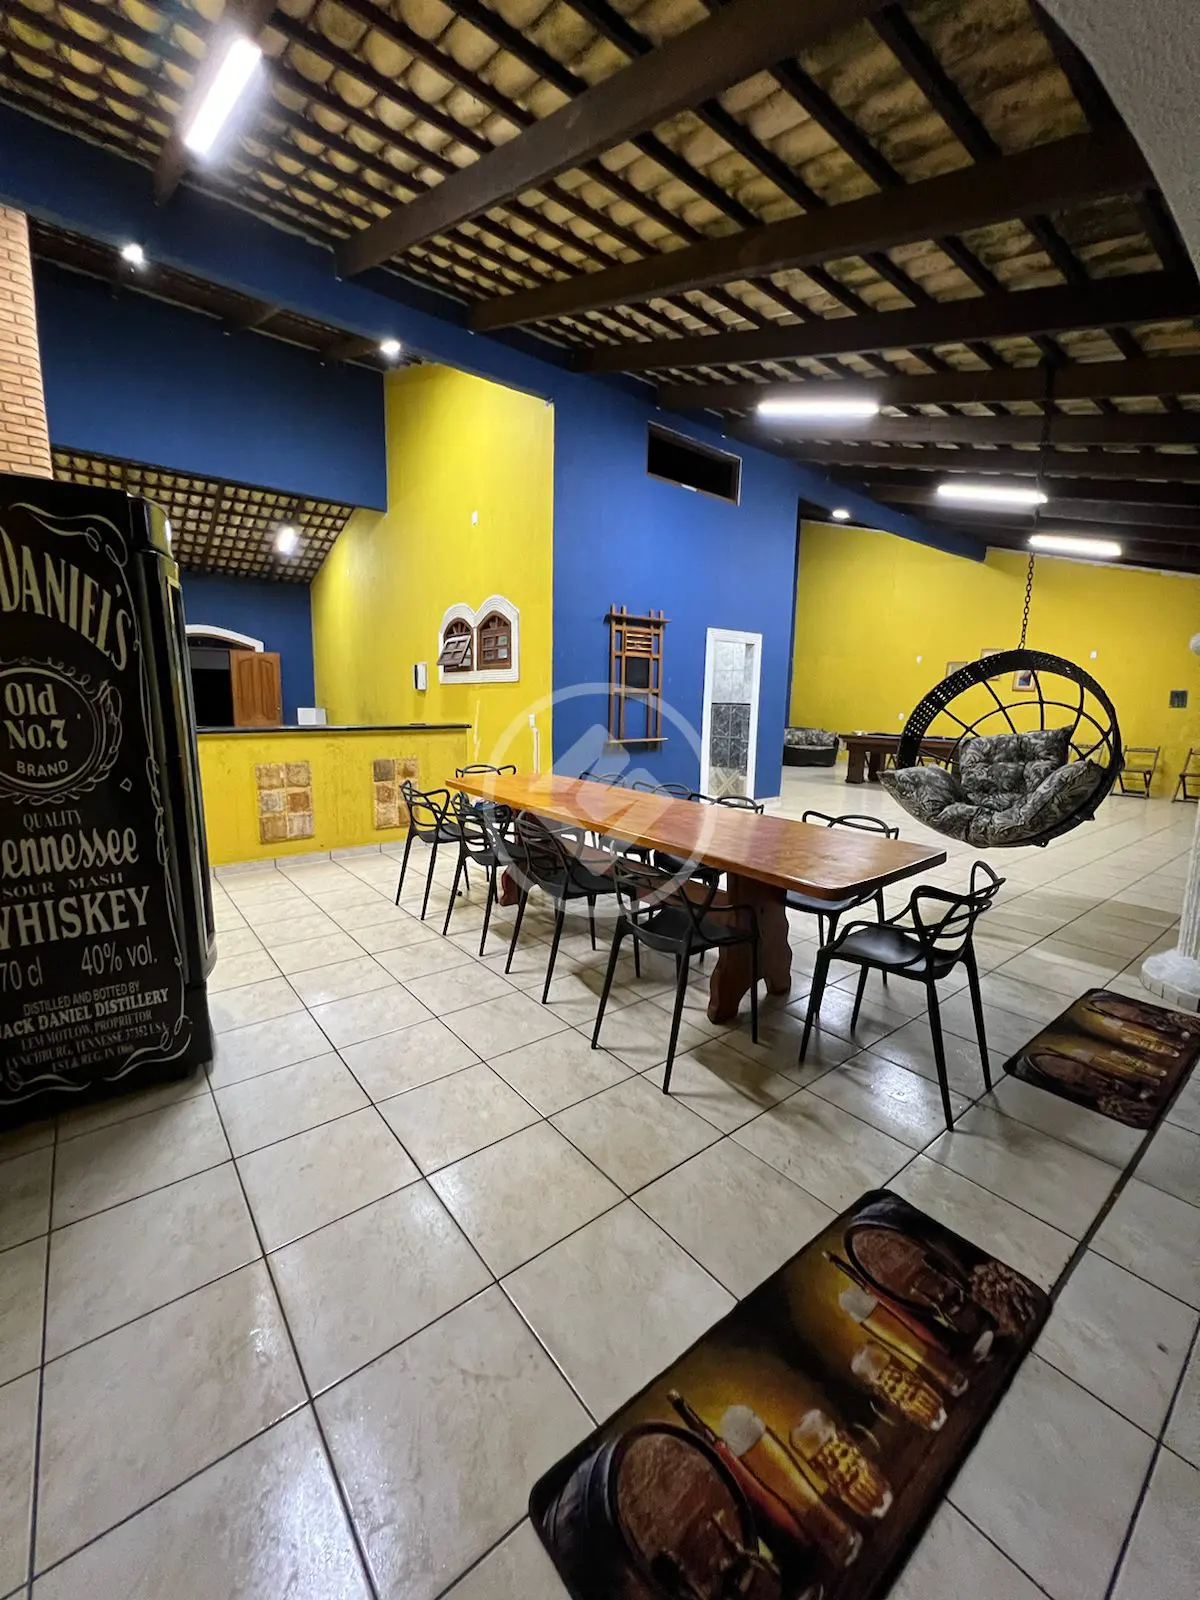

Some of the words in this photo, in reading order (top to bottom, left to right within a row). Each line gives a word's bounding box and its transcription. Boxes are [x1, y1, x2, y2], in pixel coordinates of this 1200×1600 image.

[0, 525, 132, 671] DANIEL'S
[5, 682, 58, 716] Old
[16, 759, 69, 777] BRAND
[23, 809, 81, 832] QUALITY
[2, 881, 55, 899] SOUR
[68, 872, 123, 889] MASH
[0, 961, 22, 992] 70
[81, 941, 123, 976] 40%
[127, 936, 158, 967] vol.
[23, 995, 71, 1016] DISTILLED
[72, 991, 92, 1006] AND
[128, 980, 140, 993] BY
[38, 1006, 92, 1030] DANIEL
[95, 988, 169, 1017] DISTILLERY
